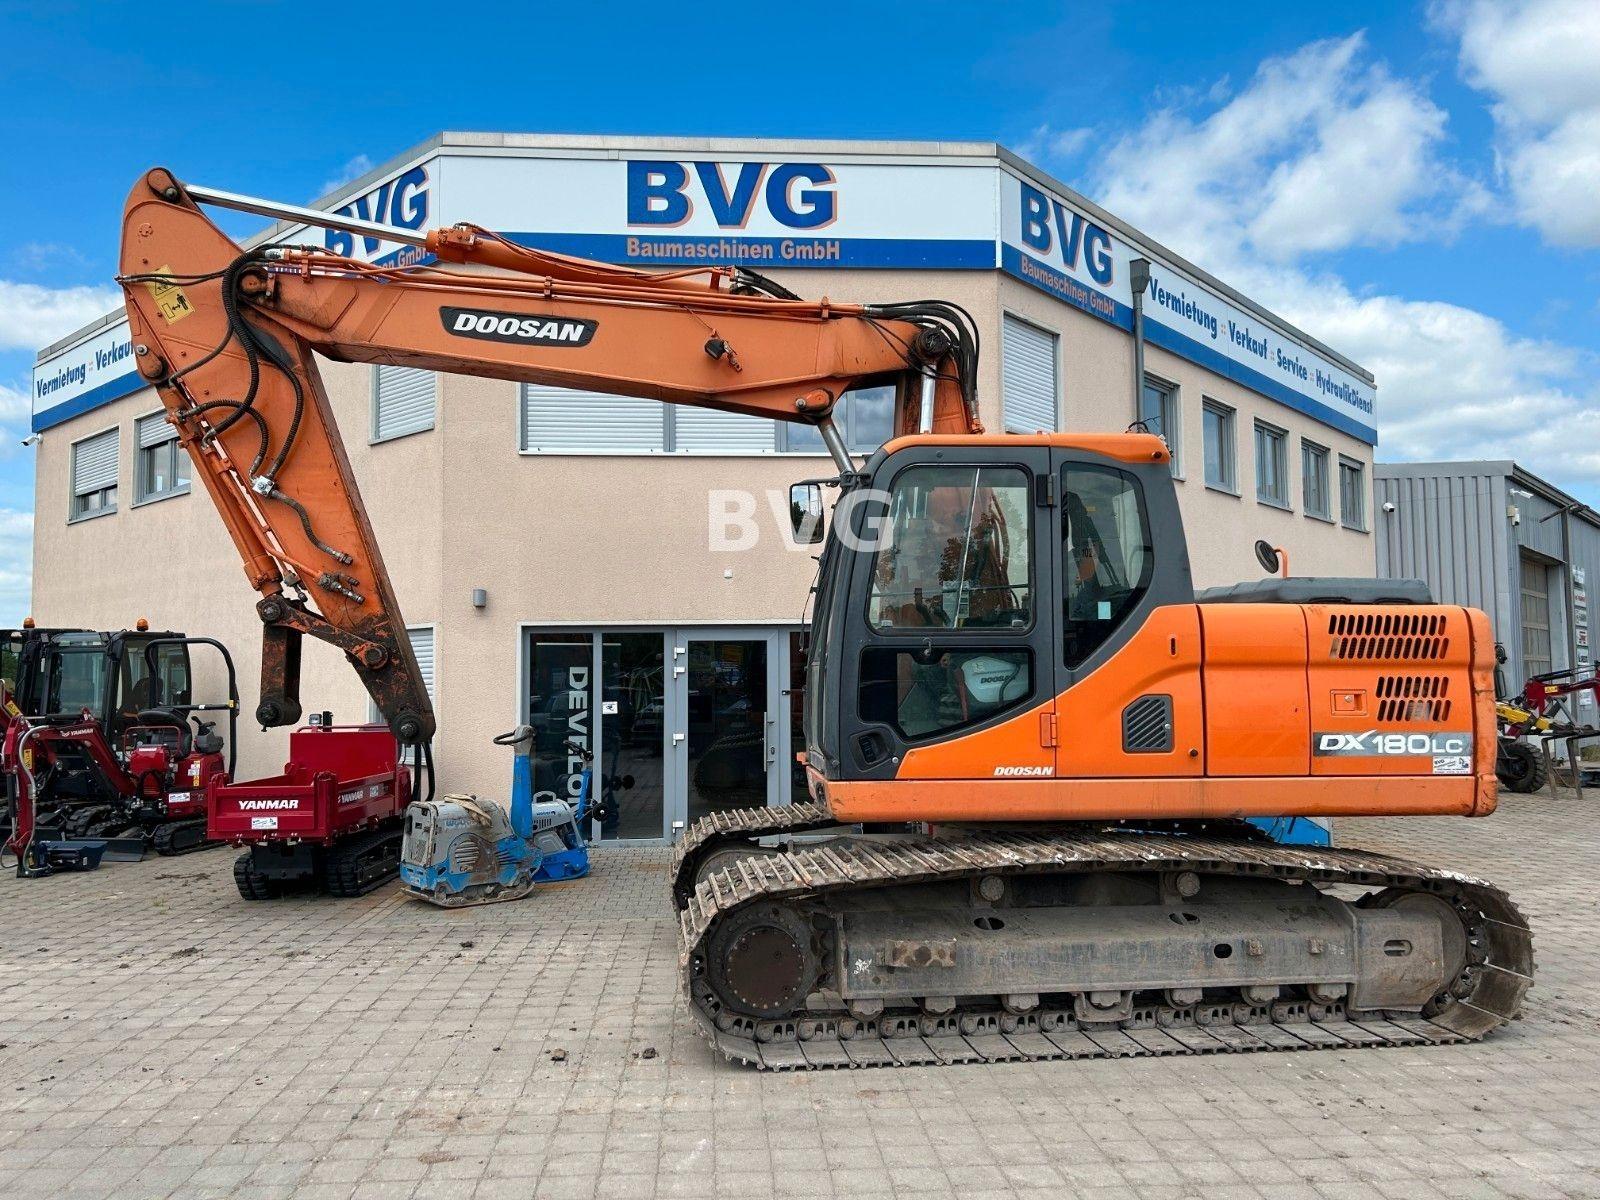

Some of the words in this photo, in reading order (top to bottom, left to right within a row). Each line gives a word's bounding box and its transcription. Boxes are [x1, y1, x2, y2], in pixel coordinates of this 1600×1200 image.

[627, 161, 838, 229] BVG
[627, 237, 774, 259] Baumaschinen
[780, 239, 840, 260] GmbH
[1021, 181, 1113, 287] BVG
[1022, 255, 1087, 304] Baumaschinen
[1090, 291, 1115, 318] GmbH
[453, 313, 585, 342] DOOSAN
[1149, 277, 1218, 340] Vermietung
[1228, 320, 1267, 359] Verkauf
[1277, 347, 1308, 381] Service
[37, 363, 86, 398] Vermietung
[567, 667, 588, 812] DEVELO
[994, 766, 1054, 776] DOOSAN
[238, 800, 299, 810] YANMAR
